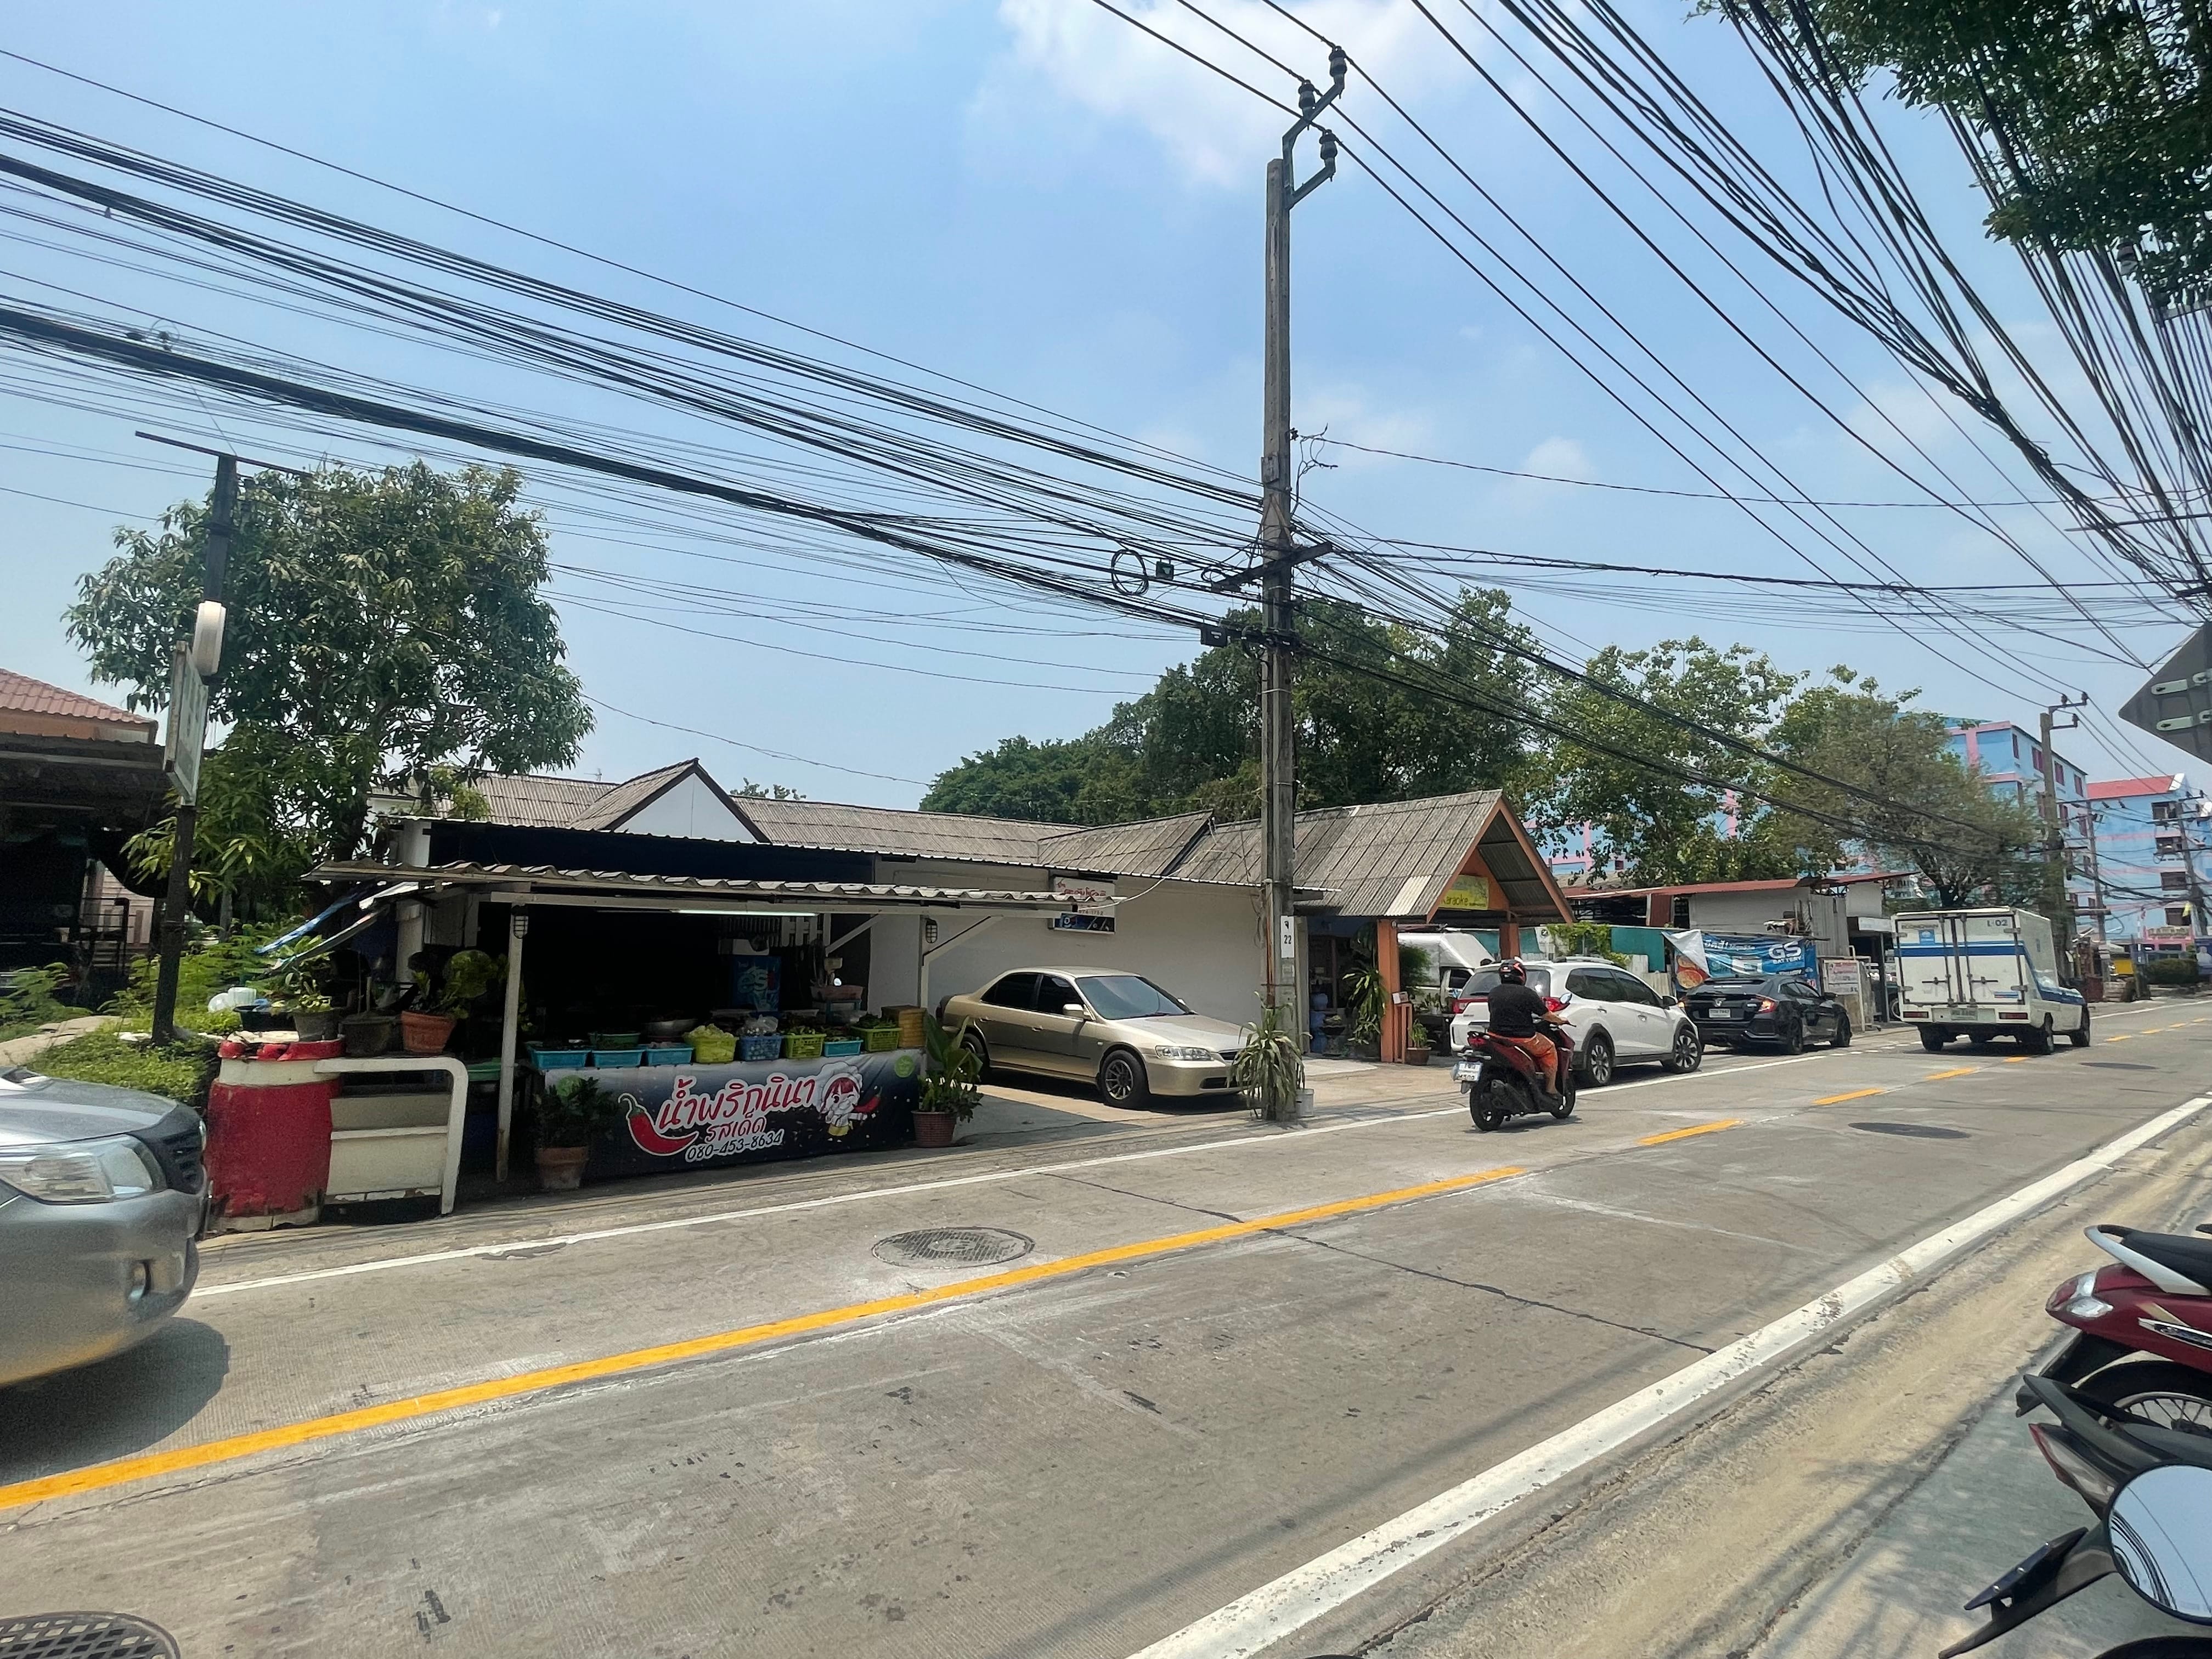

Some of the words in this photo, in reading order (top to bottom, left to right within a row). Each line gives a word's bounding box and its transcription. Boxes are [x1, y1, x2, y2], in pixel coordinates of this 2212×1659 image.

[1284, 934, 1291, 944] 22
[1768, 941, 1802, 959] GS
[1773, 956, 1802, 964] BATTERY
[659, 1076, 815, 1129] น้ำพริกนินา
[706, 1108, 766, 1142] รสเด็ด
[687, 1131, 782, 1160] 080-453-8634
